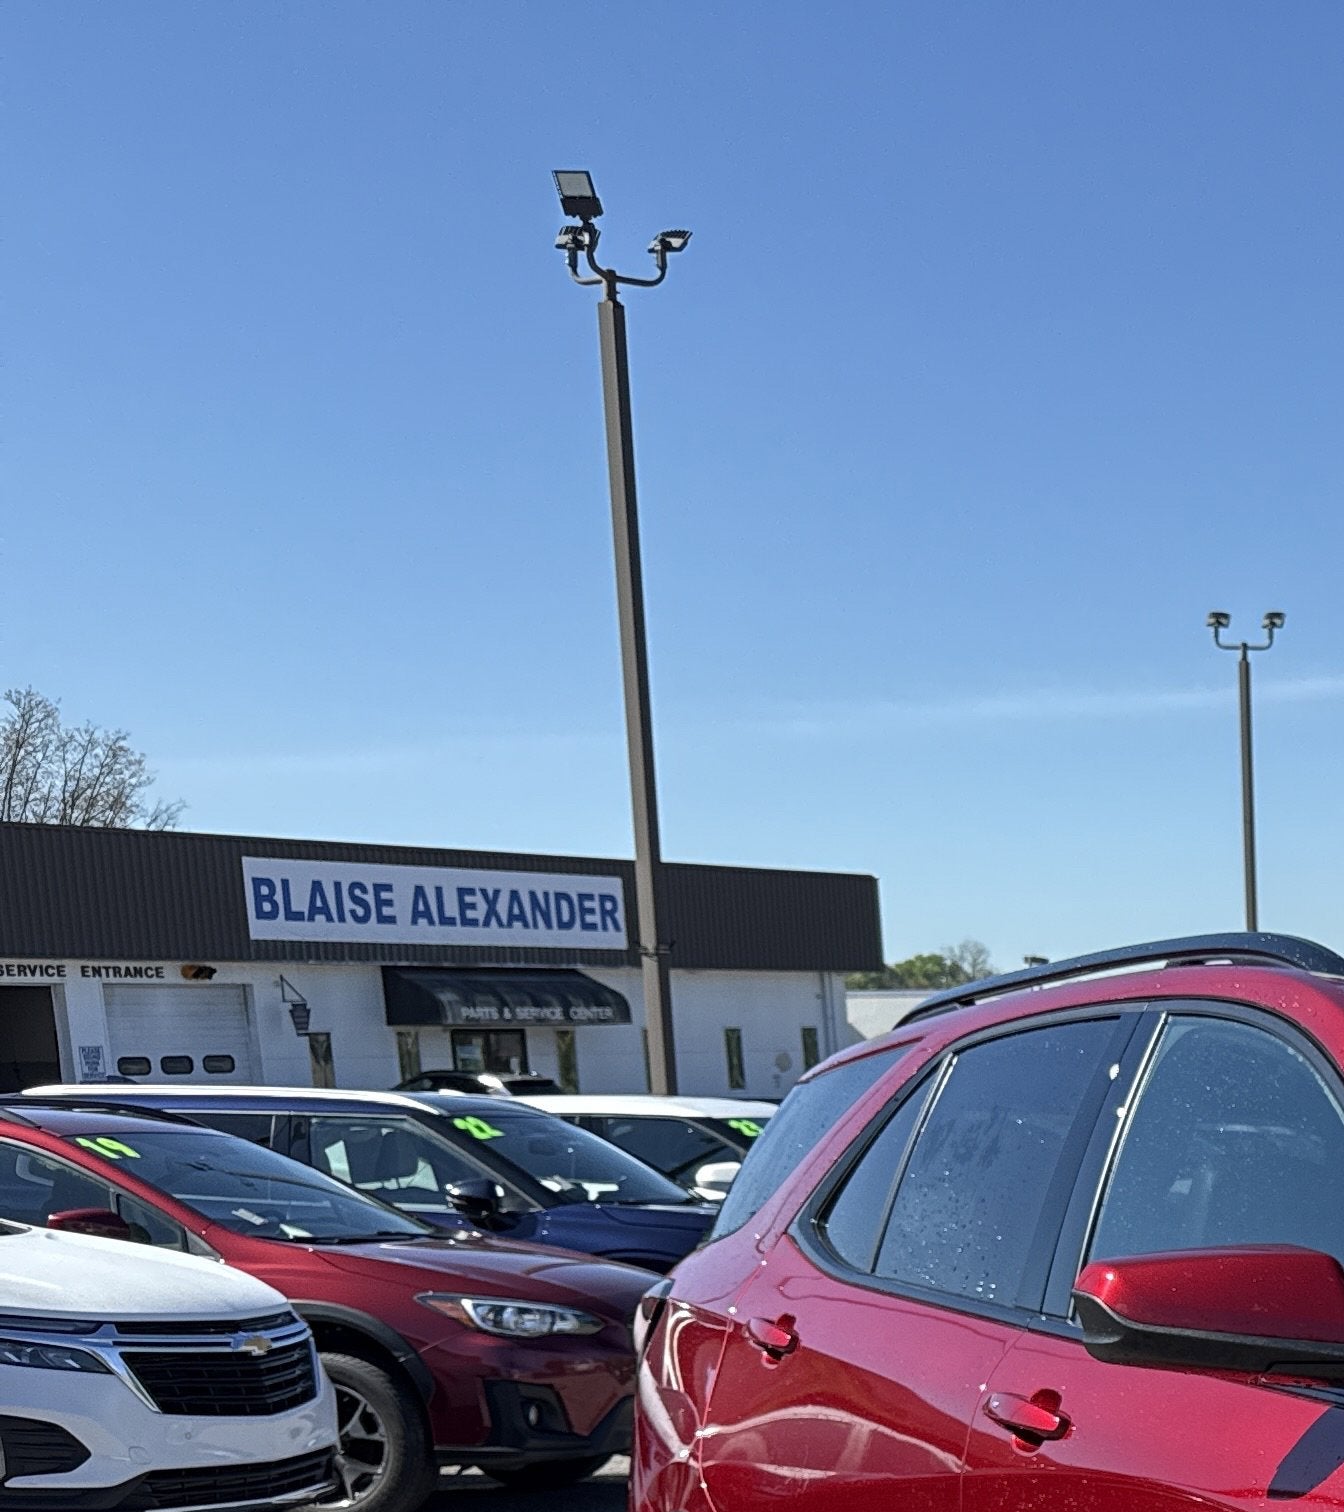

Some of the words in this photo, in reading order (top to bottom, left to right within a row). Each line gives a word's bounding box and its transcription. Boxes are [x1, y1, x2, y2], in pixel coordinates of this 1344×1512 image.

[250, 876, 398, 926] BLAISE
[410, 884, 622, 933] ALEXANDER
[80, 965, 165, 979] ENTRANCE
[460, 1006, 499, 1020] PARTS
[569, 1006, 614, 1020] CENTER
[75, 1137, 141, 1159] 19
